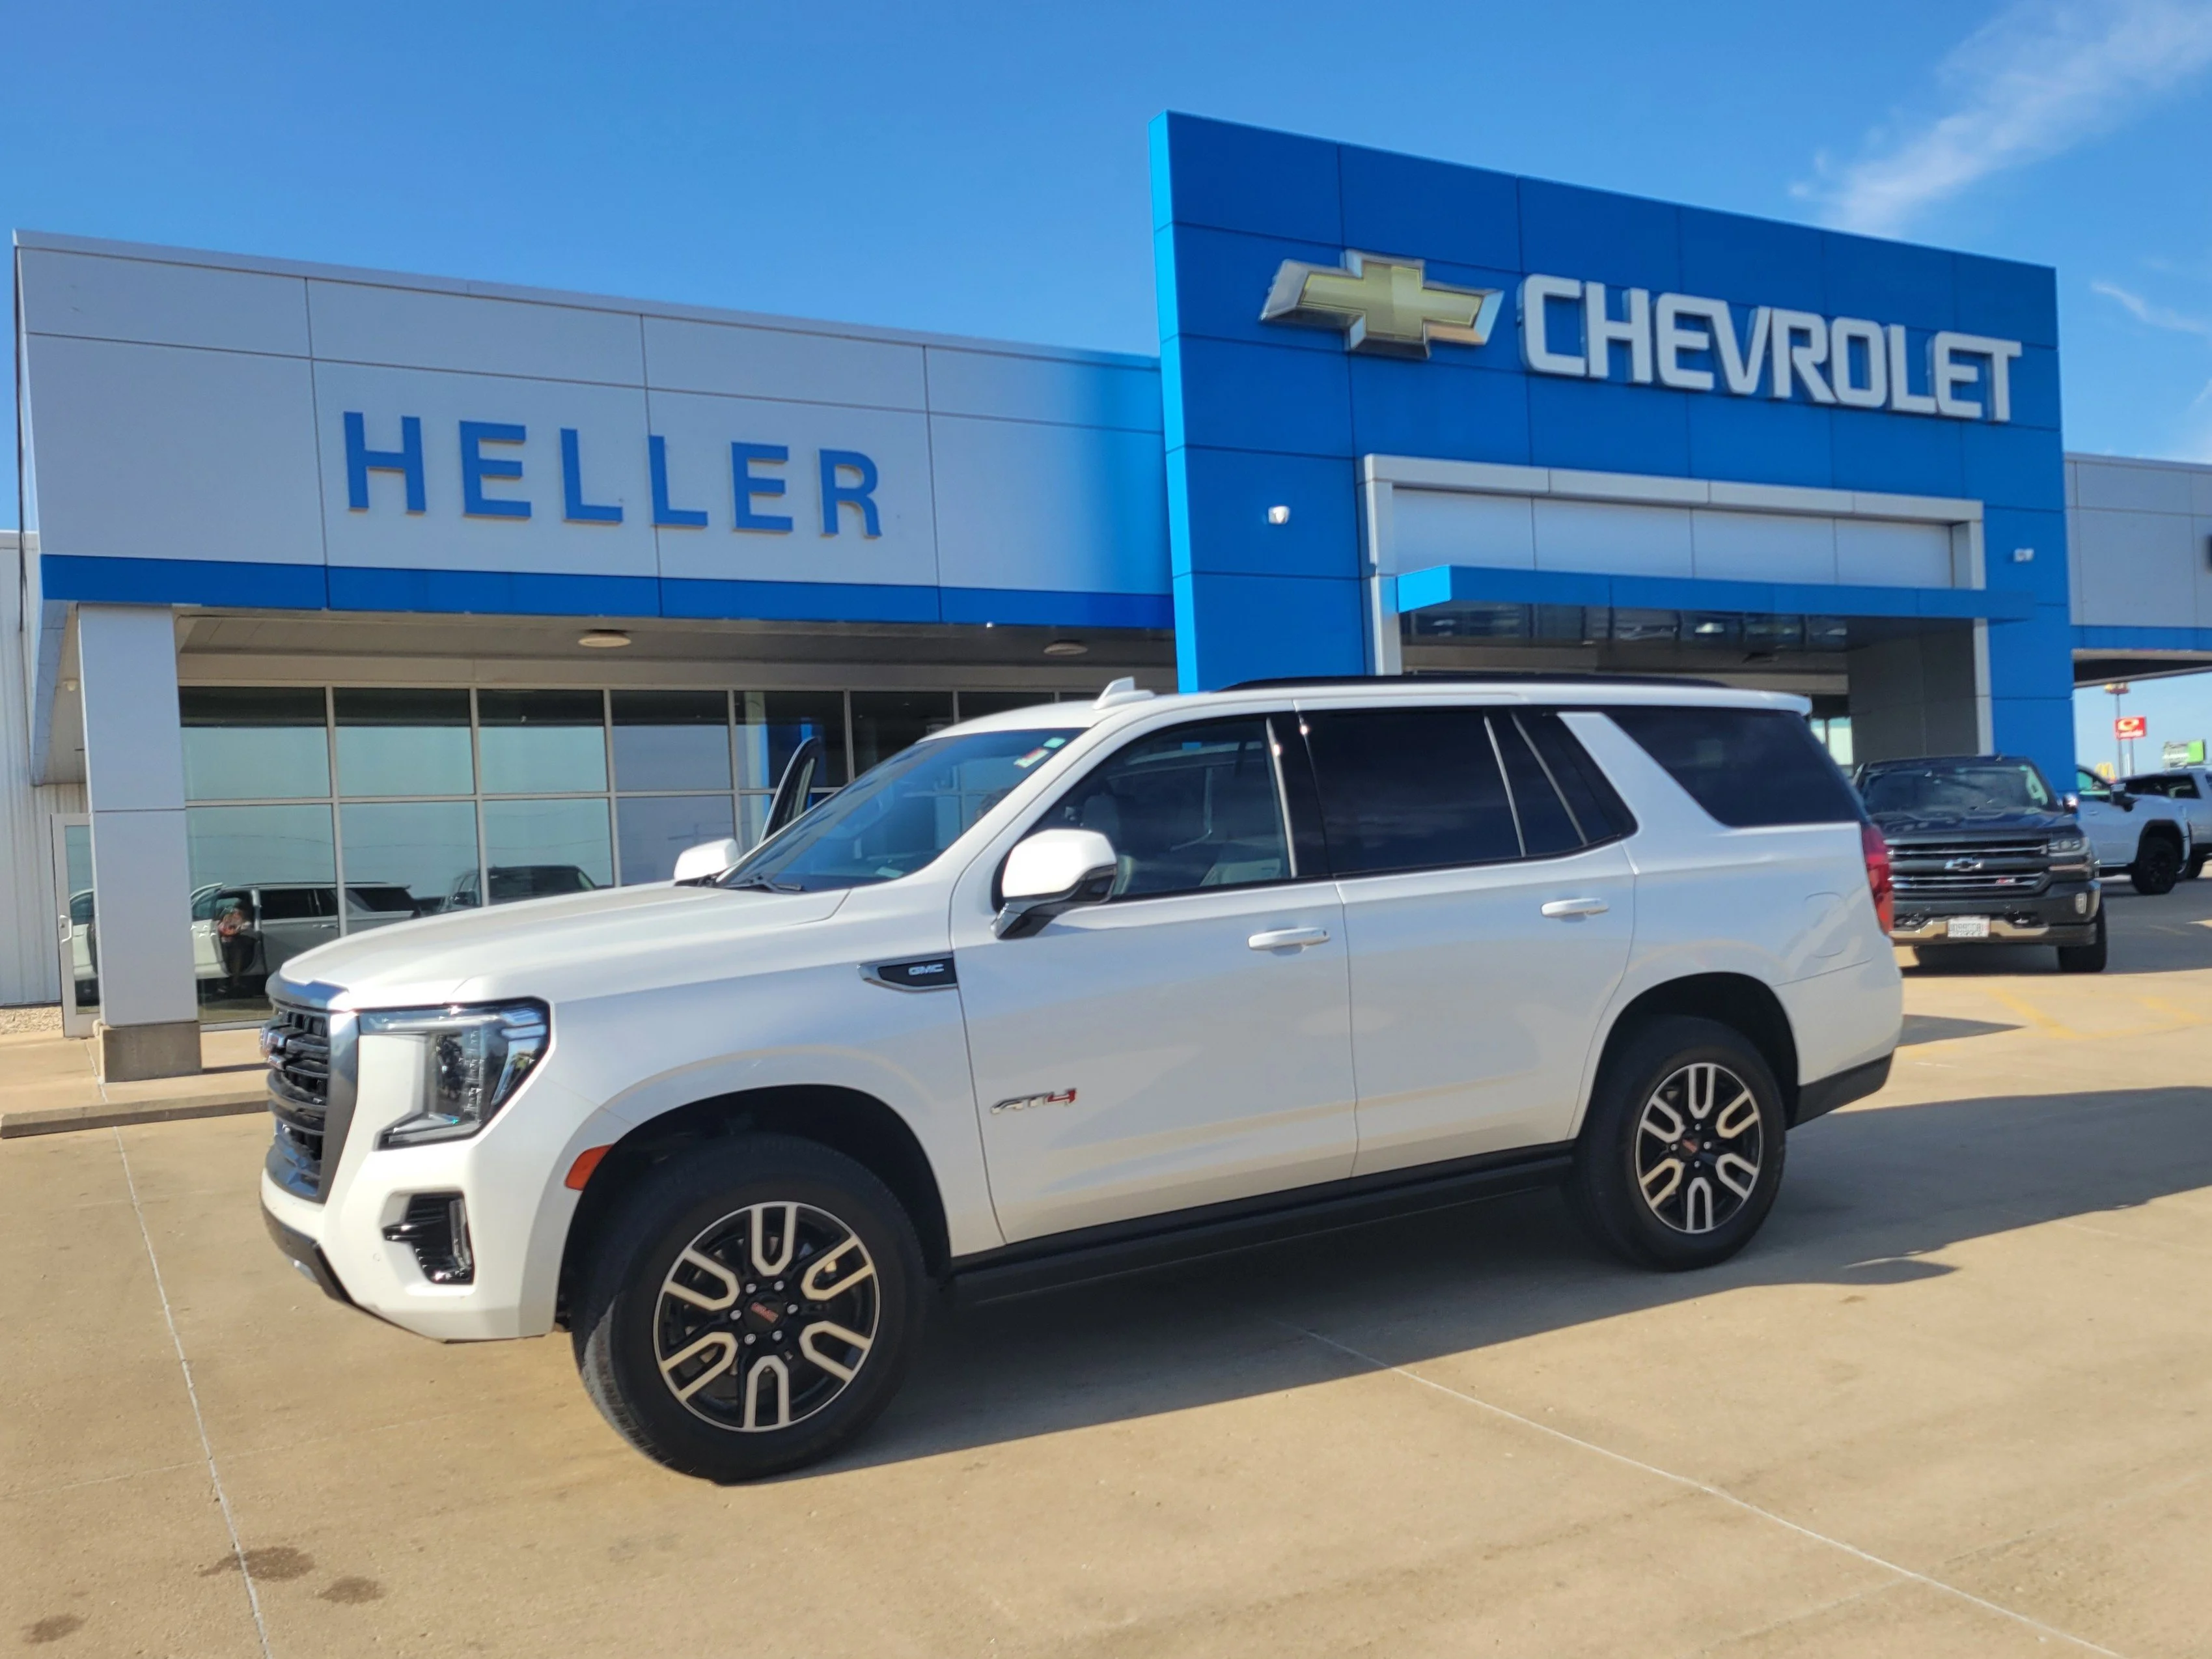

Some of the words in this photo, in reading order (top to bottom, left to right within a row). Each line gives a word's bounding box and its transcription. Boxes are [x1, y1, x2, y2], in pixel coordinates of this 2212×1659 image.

[1516, 273, 2023, 423] CHEVROLET
[343, 410, 882, 539] HELLER
[908, 964, 945, 976] GMC
[990, 1087, 1077, 1115] AT4
